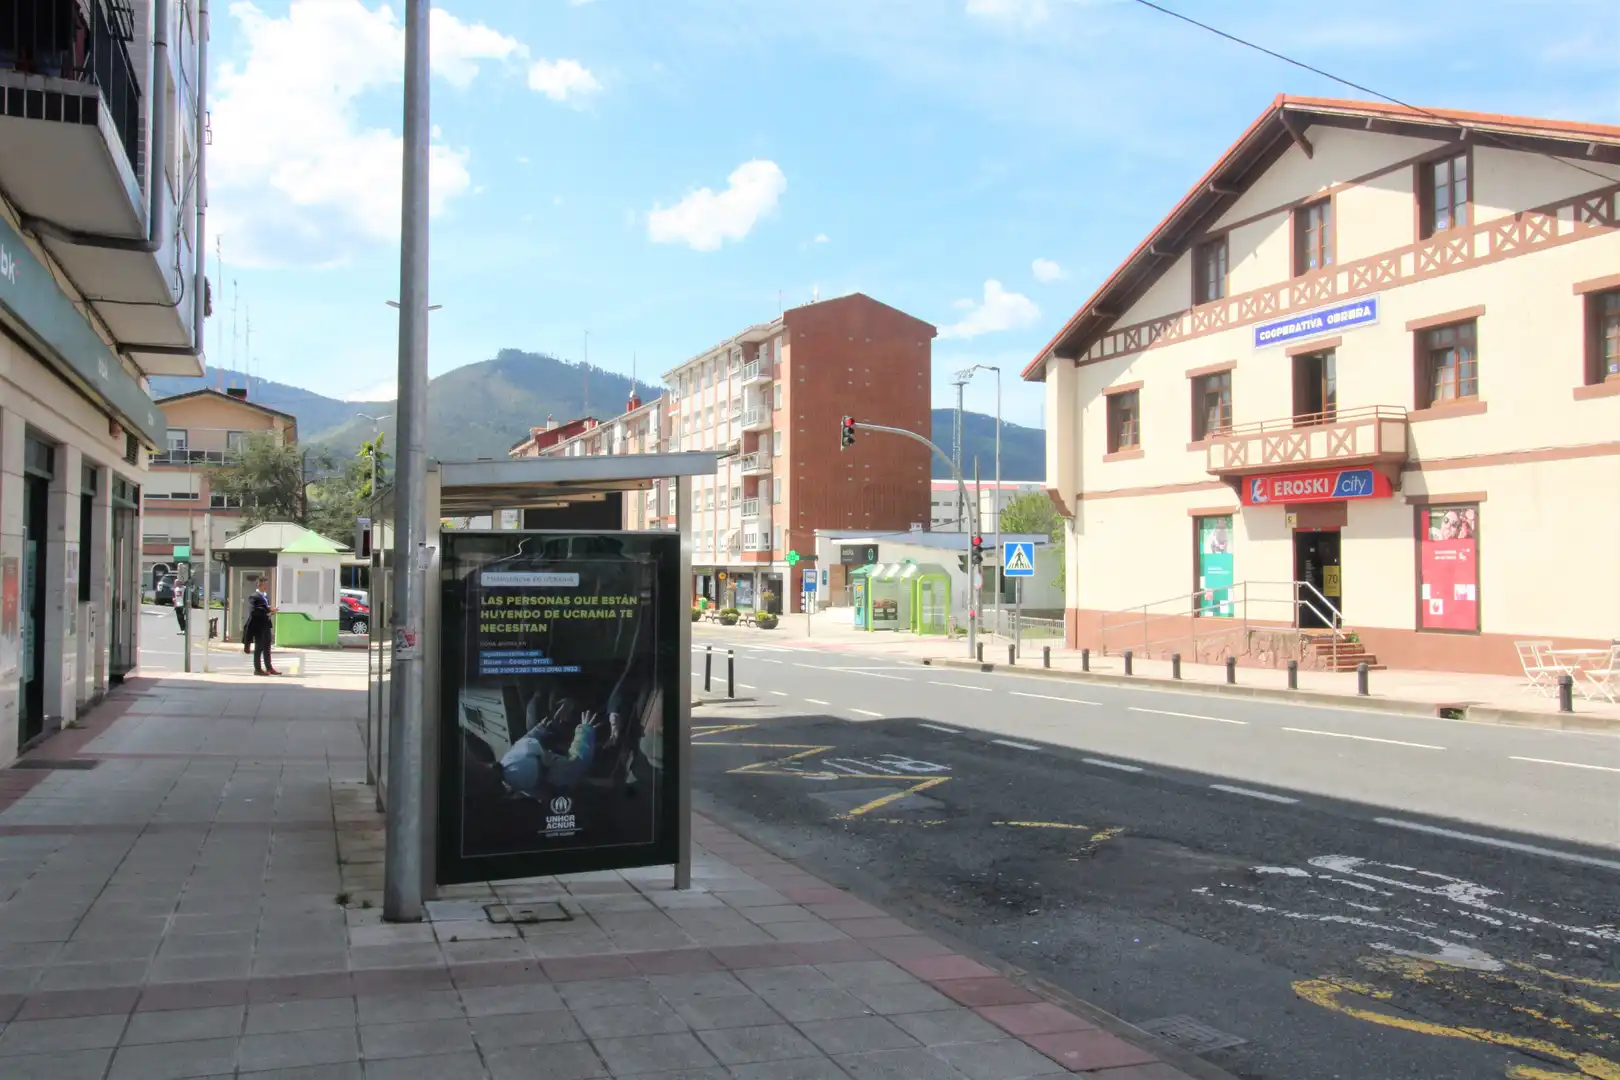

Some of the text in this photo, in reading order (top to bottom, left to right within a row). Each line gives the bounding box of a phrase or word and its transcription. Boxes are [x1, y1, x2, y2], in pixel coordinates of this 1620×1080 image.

[1259, 305, 1372, 341] COOPERATIVA OBRERA
[1274, 475, 1367, 497] EROSKI city
[481, 593, 638, 606] LAS PERSONAS QUE ESTÁN
[480, 609, 633, 619] HUYENDO DE UCRANIA TE
[480, 623, 548, 633] NECESITAN
[546, 814, 576, 823] UNHCR
[546, 821, 576, 830] ACNUR
